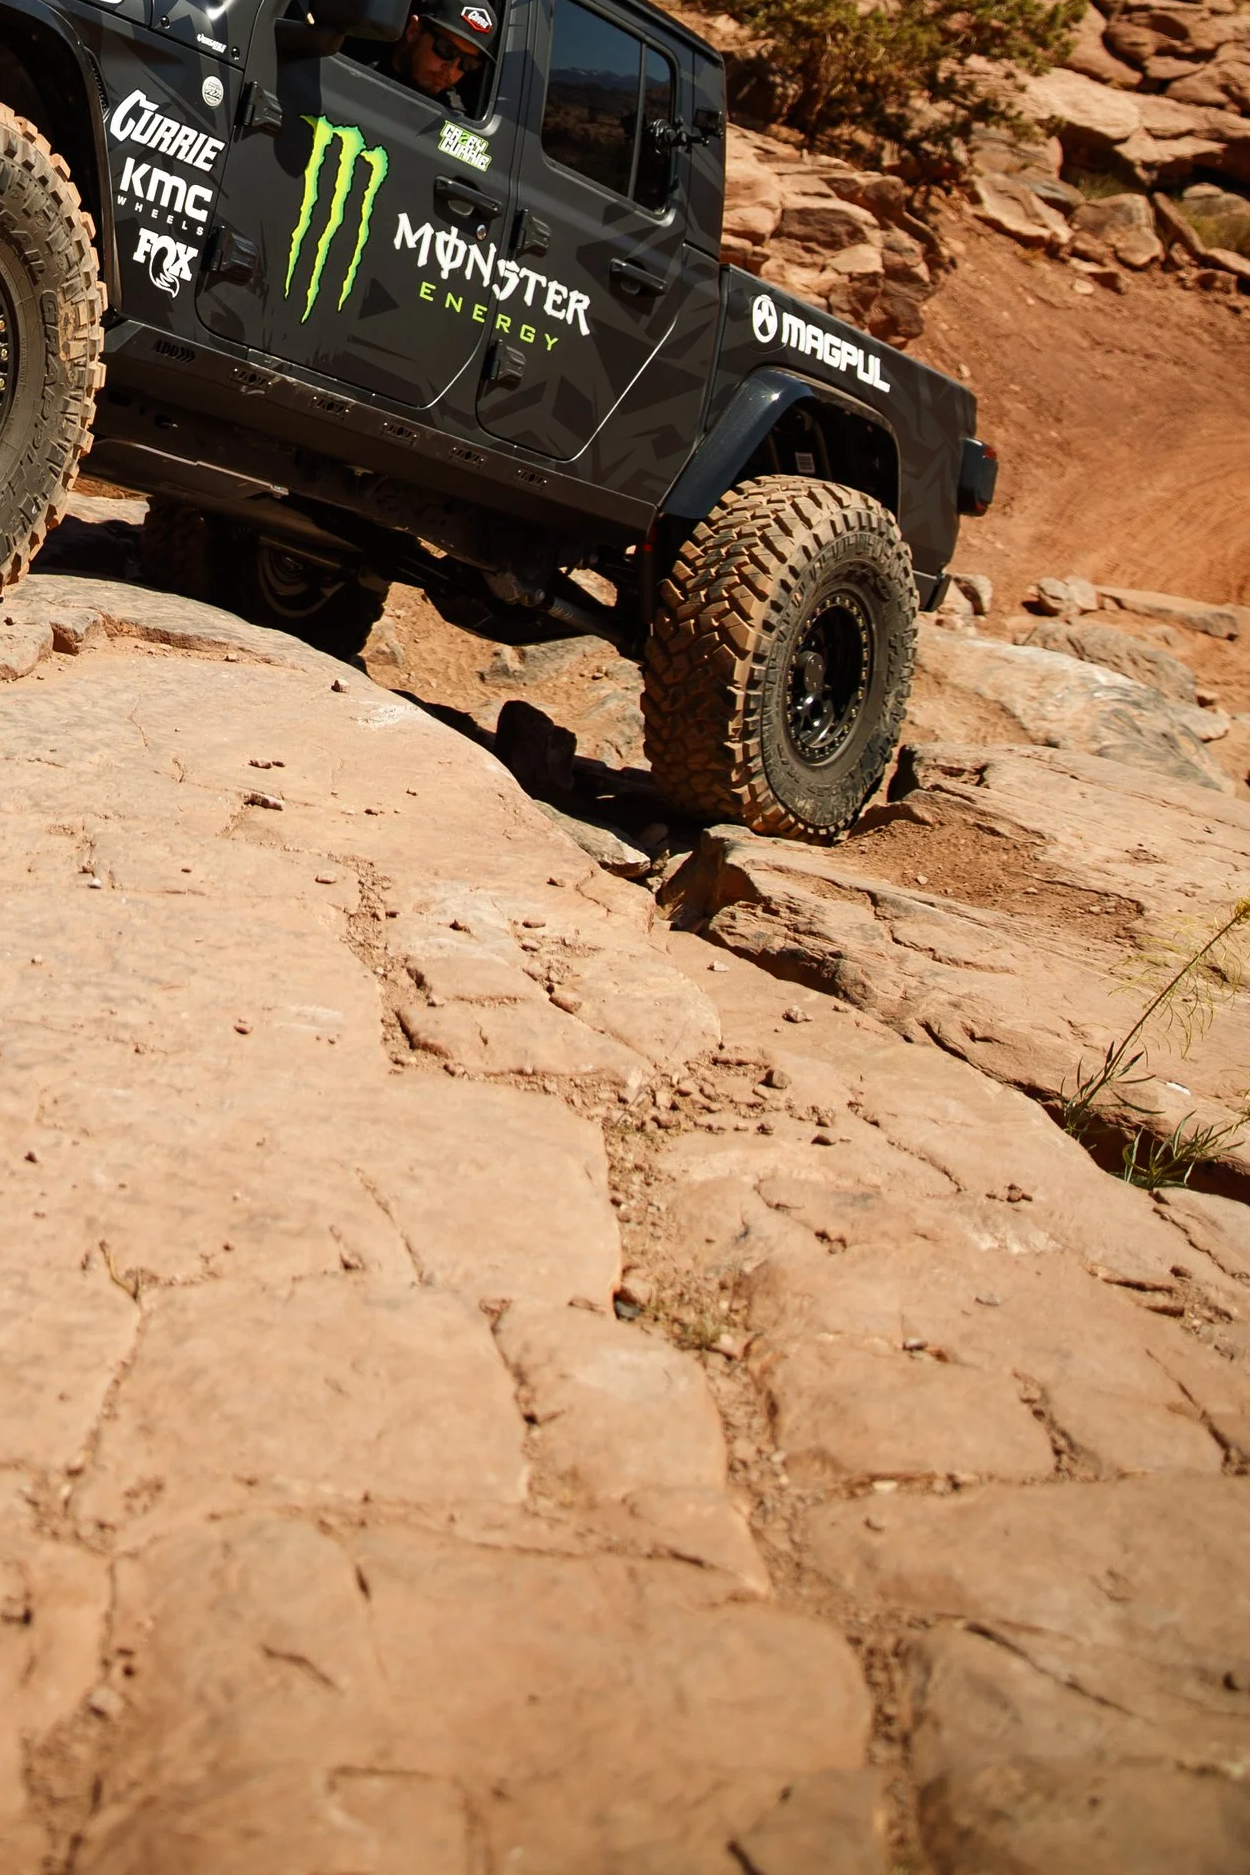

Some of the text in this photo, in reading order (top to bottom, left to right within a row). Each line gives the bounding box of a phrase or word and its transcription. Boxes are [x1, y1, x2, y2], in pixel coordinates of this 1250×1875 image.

[110, 89, 226, 172] CURRIE
[117, 194, 204, 236] WHEELS
[132, 227, 199, 298] FOX
[419, 281, 559, 351] ENERGY
[781, 312, 891, 393] MAGPUL
